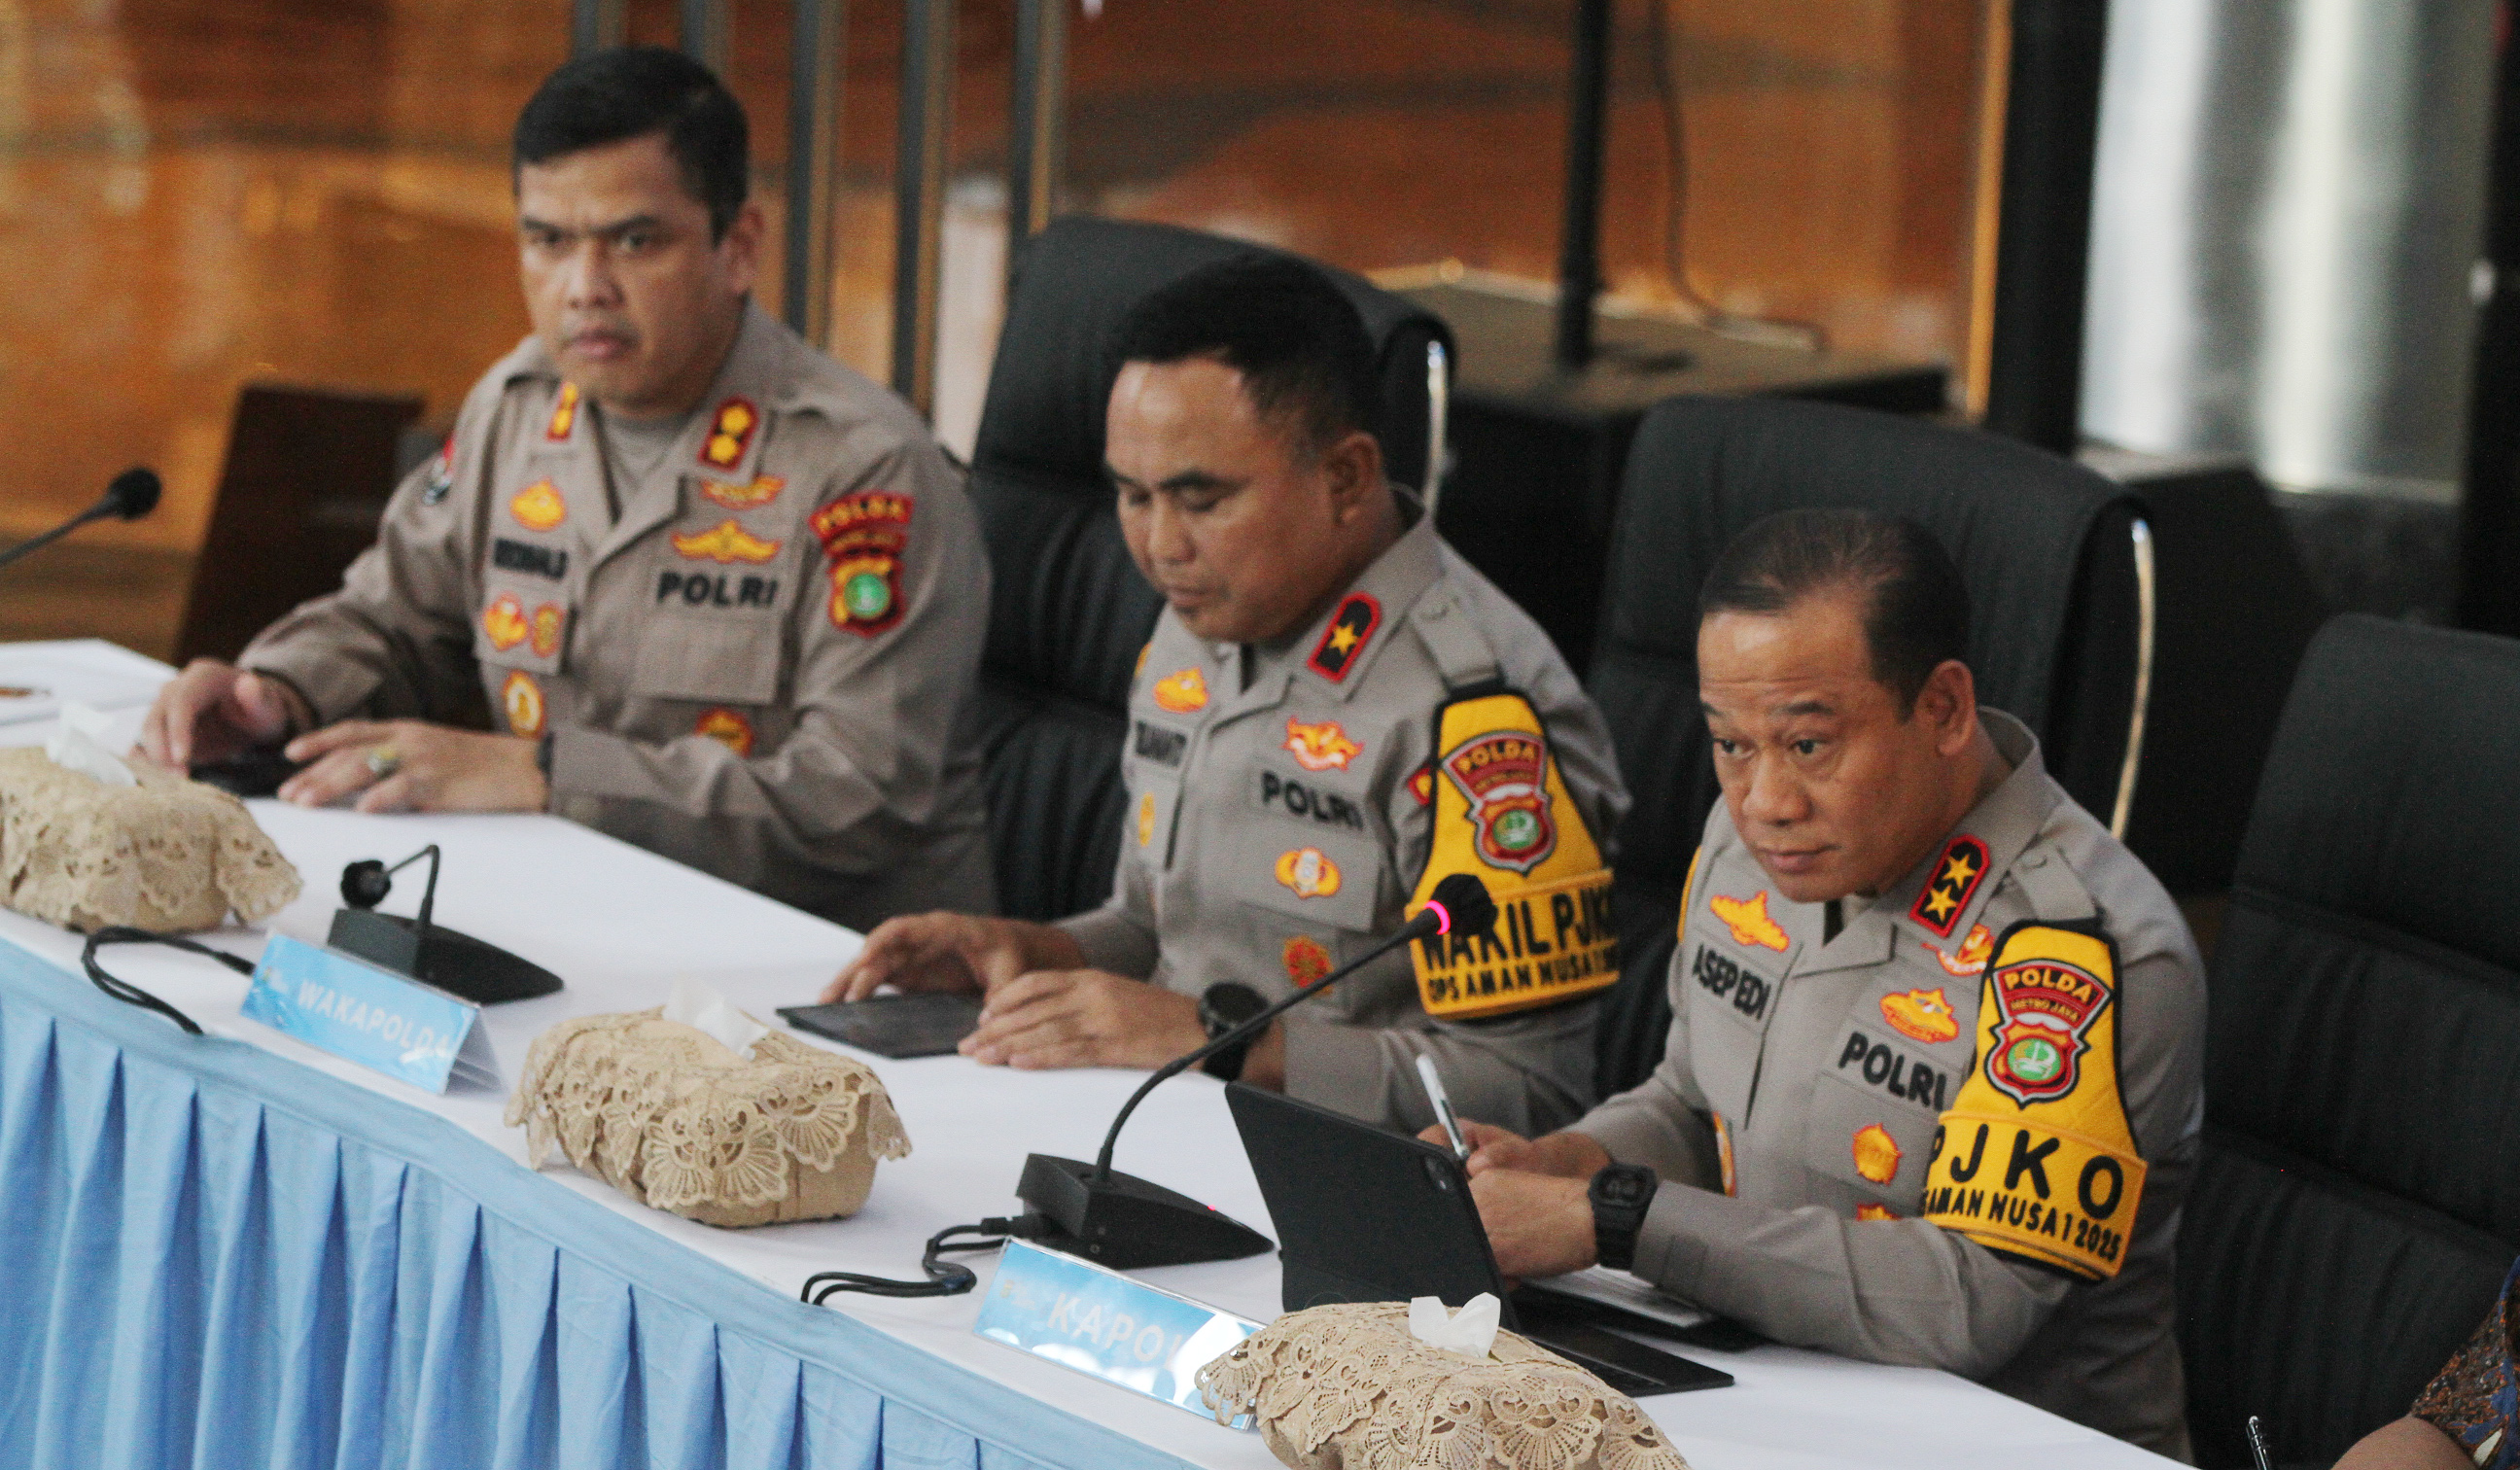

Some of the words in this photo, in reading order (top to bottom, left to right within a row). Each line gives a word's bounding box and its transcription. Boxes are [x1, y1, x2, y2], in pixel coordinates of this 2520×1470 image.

[656, 570, 778, 608] POLRI
[1457, 739, 1535, 775] POLDA
[1261, 770, 1363, 830] POLRI
[2004, 967, 2092, 1004] POLDA
[298, 979, 450, 1057] WAKAPOLDA
[1838, 1031, 1947, 1112] POLRI
[1988, 1192, 2057, 1238] NUSA
[2074, 1219, 2121, 1263] 2025
